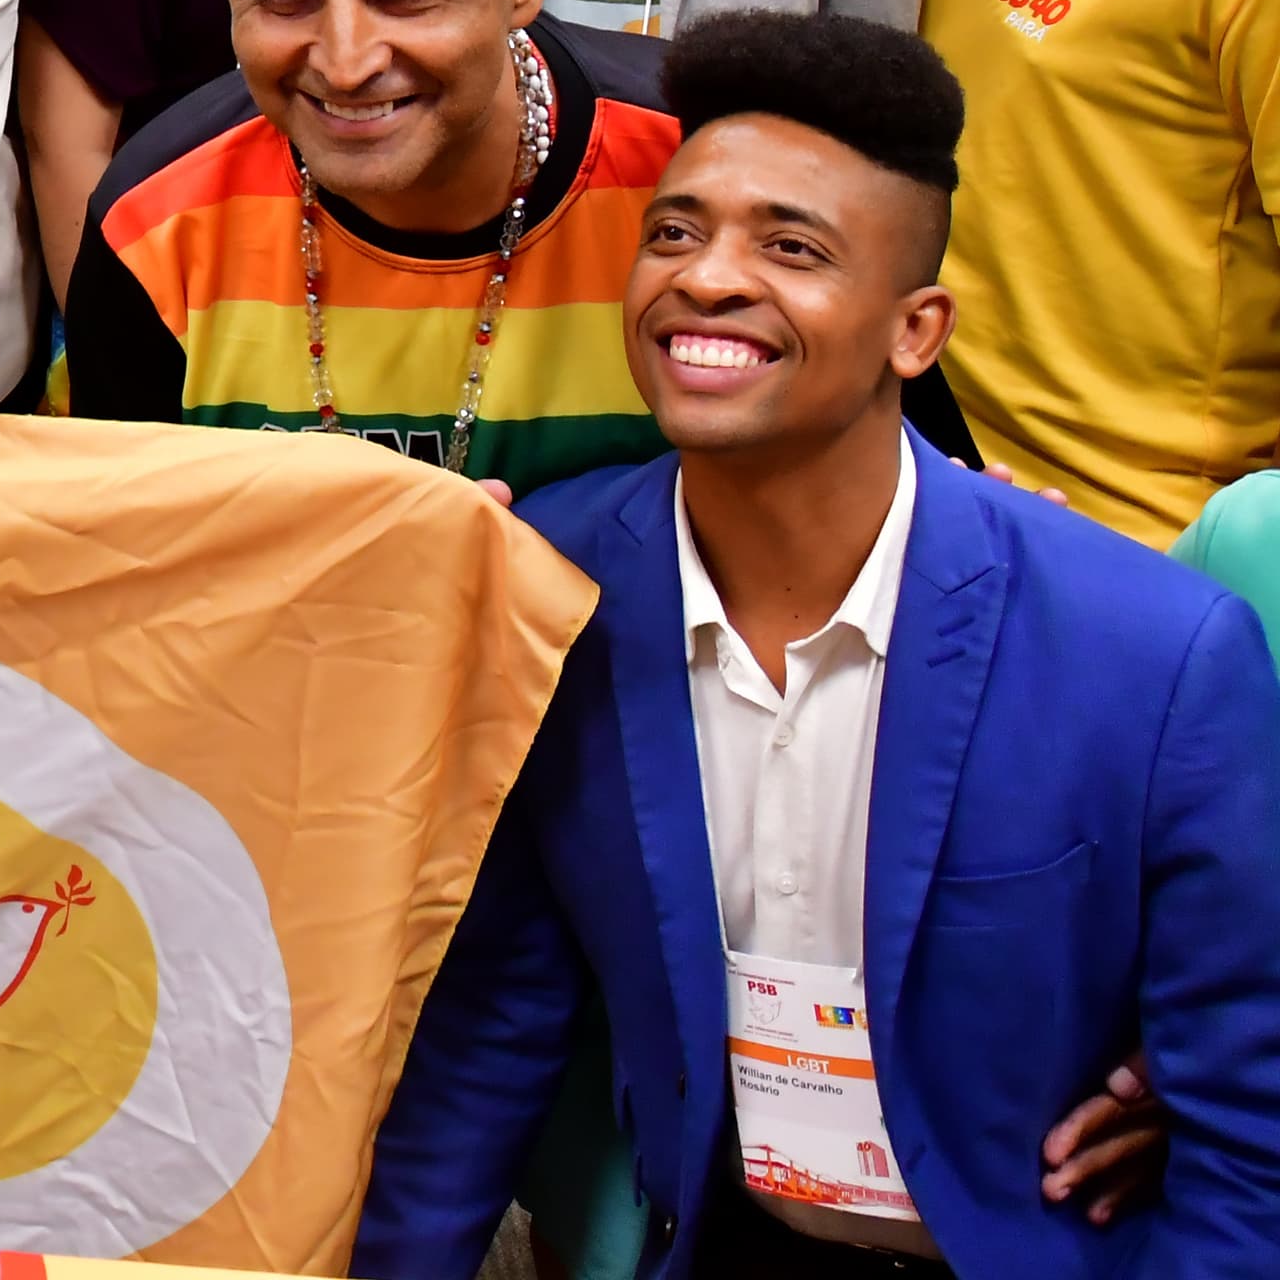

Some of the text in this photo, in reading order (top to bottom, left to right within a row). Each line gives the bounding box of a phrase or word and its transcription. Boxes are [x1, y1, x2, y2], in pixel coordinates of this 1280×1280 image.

[747, 980, 778, 996] PSB
[787, 1055, 830, 1073] LGBT
[737, 1064, 844, 1096] Willian de Carvalho
[739, 1078, 780, 1097] Rosário
